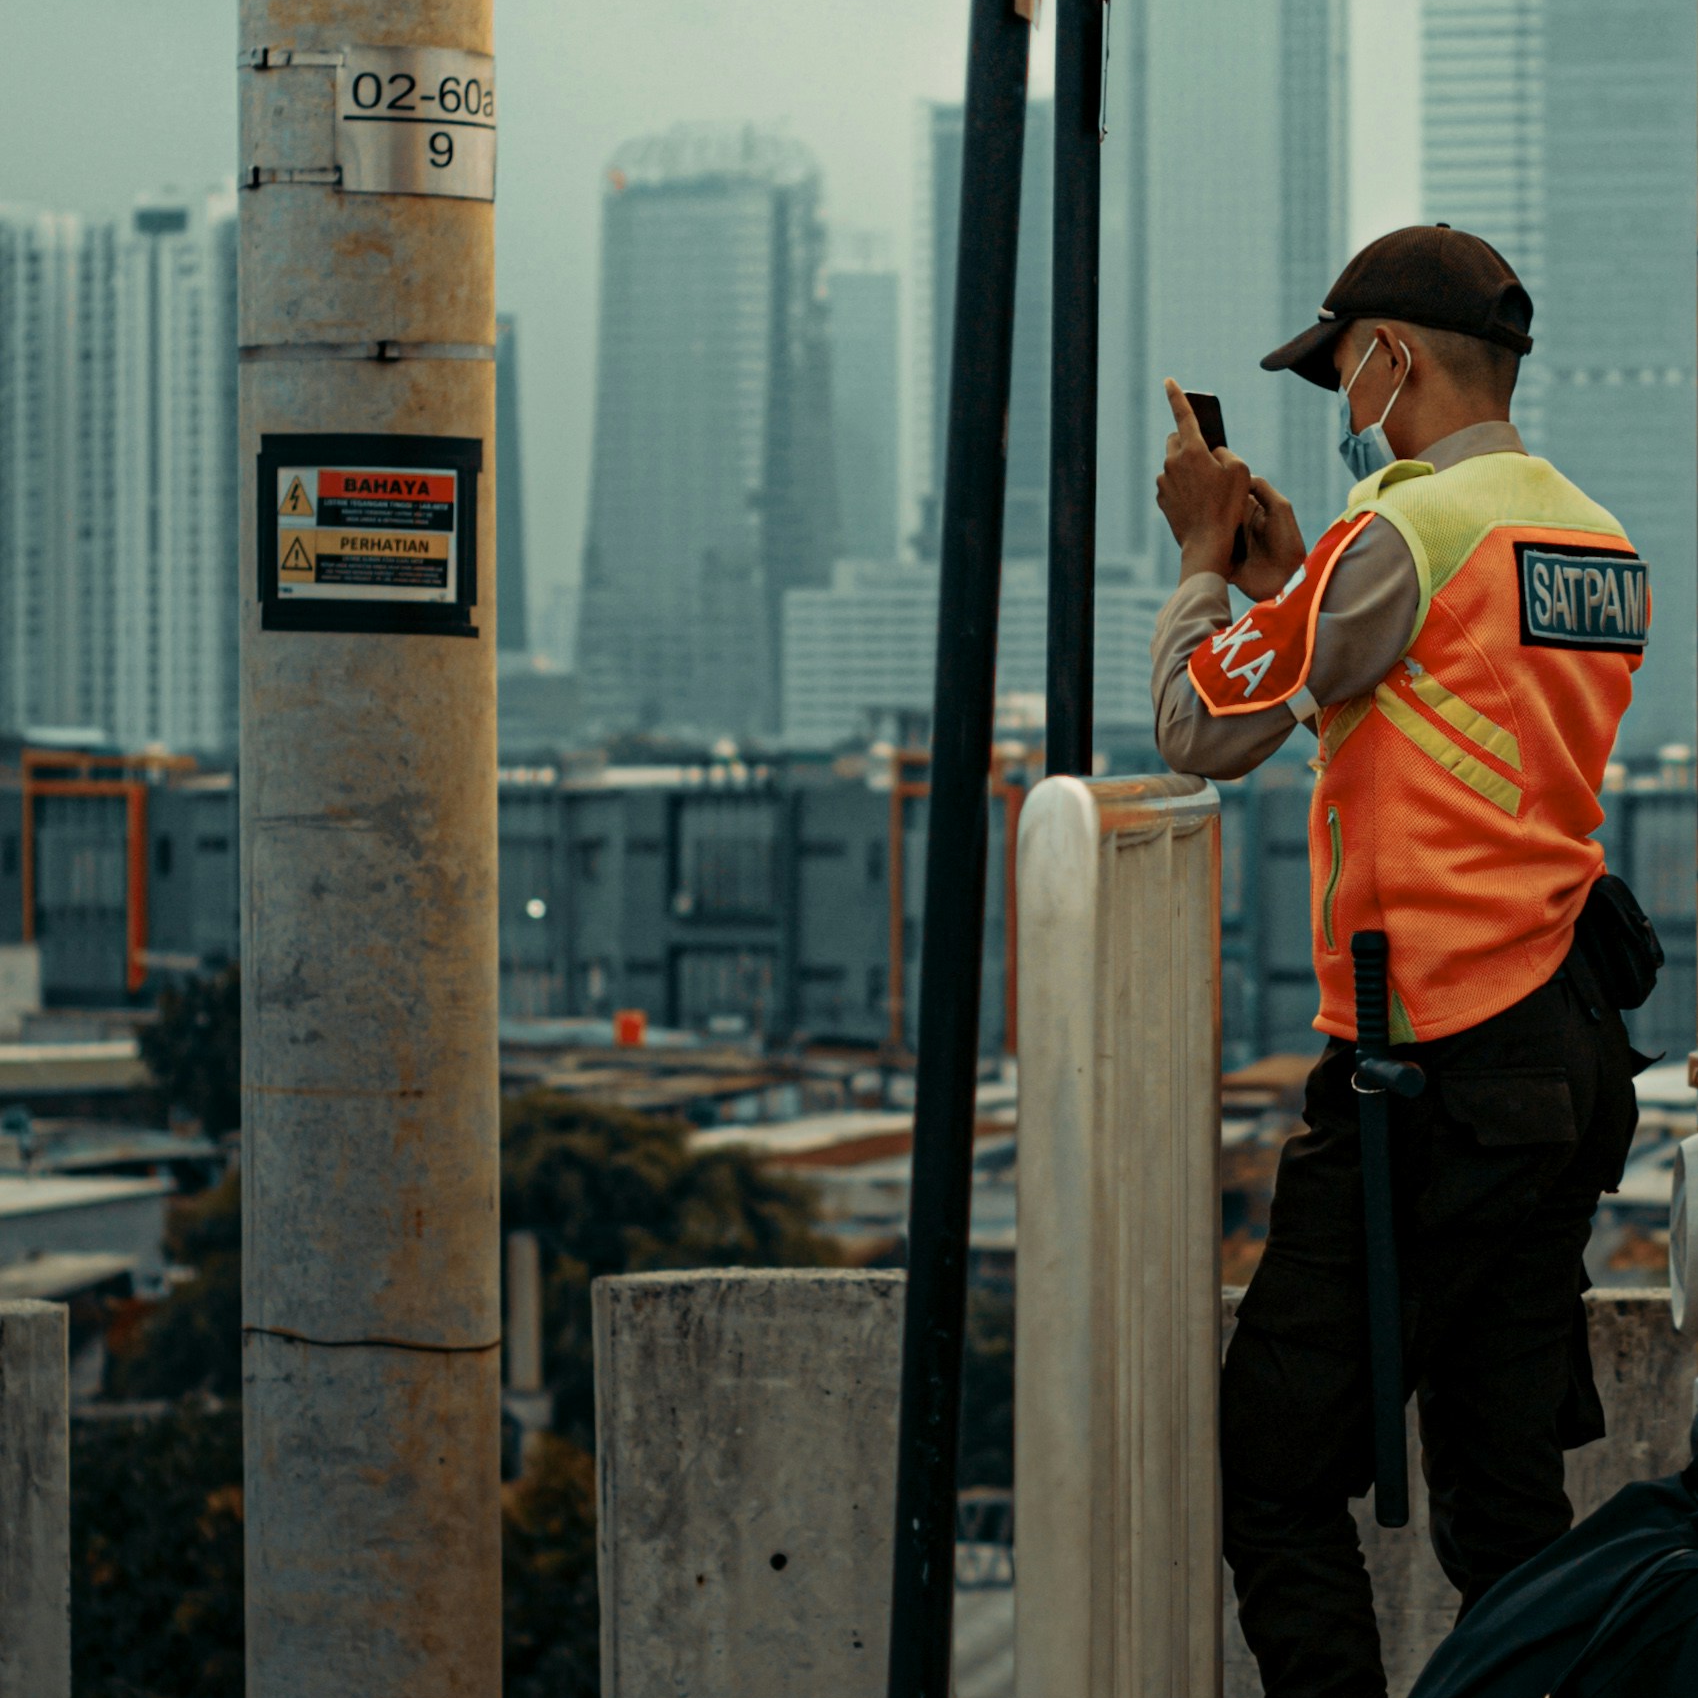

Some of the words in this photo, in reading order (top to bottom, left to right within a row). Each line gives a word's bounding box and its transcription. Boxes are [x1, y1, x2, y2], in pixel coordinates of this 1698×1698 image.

[429, 131, 454, 169] 9
[343, 477, 431, 497] BAHAYA
[340, 536, 430, 554] PERHATIAN
[1533, 562, 1645, 636] SATPAM
